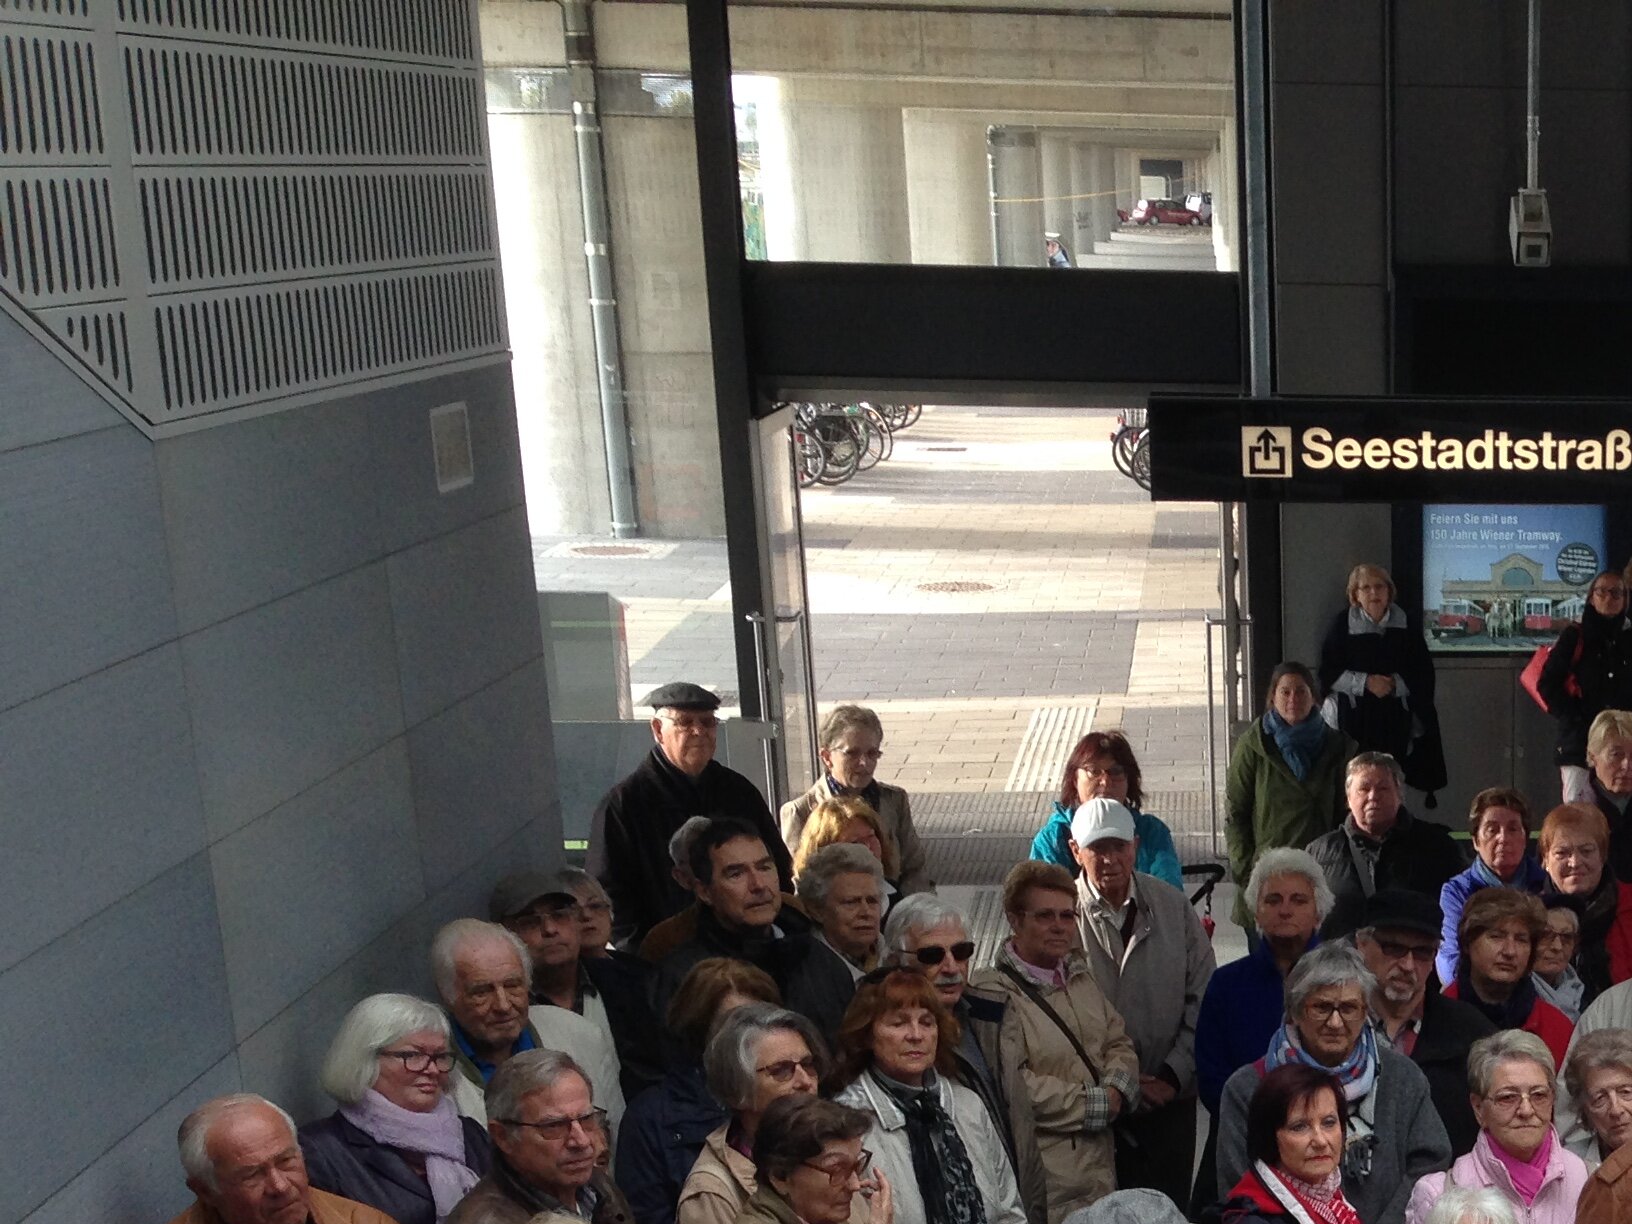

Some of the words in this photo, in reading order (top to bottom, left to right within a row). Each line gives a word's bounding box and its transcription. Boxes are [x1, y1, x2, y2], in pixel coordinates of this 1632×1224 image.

[1430, 513, 1461, 524] Feiern
[1463, 513, 1480, 525] Sie
[1482, 513, 1498, 525] mit
[1500, 515, 1518, 525] uns
[1430, 529, 1447, 540] 150
[1450, 529, 1478, 541] Jahre
[1480, 529, 1514, 541] Wiener
